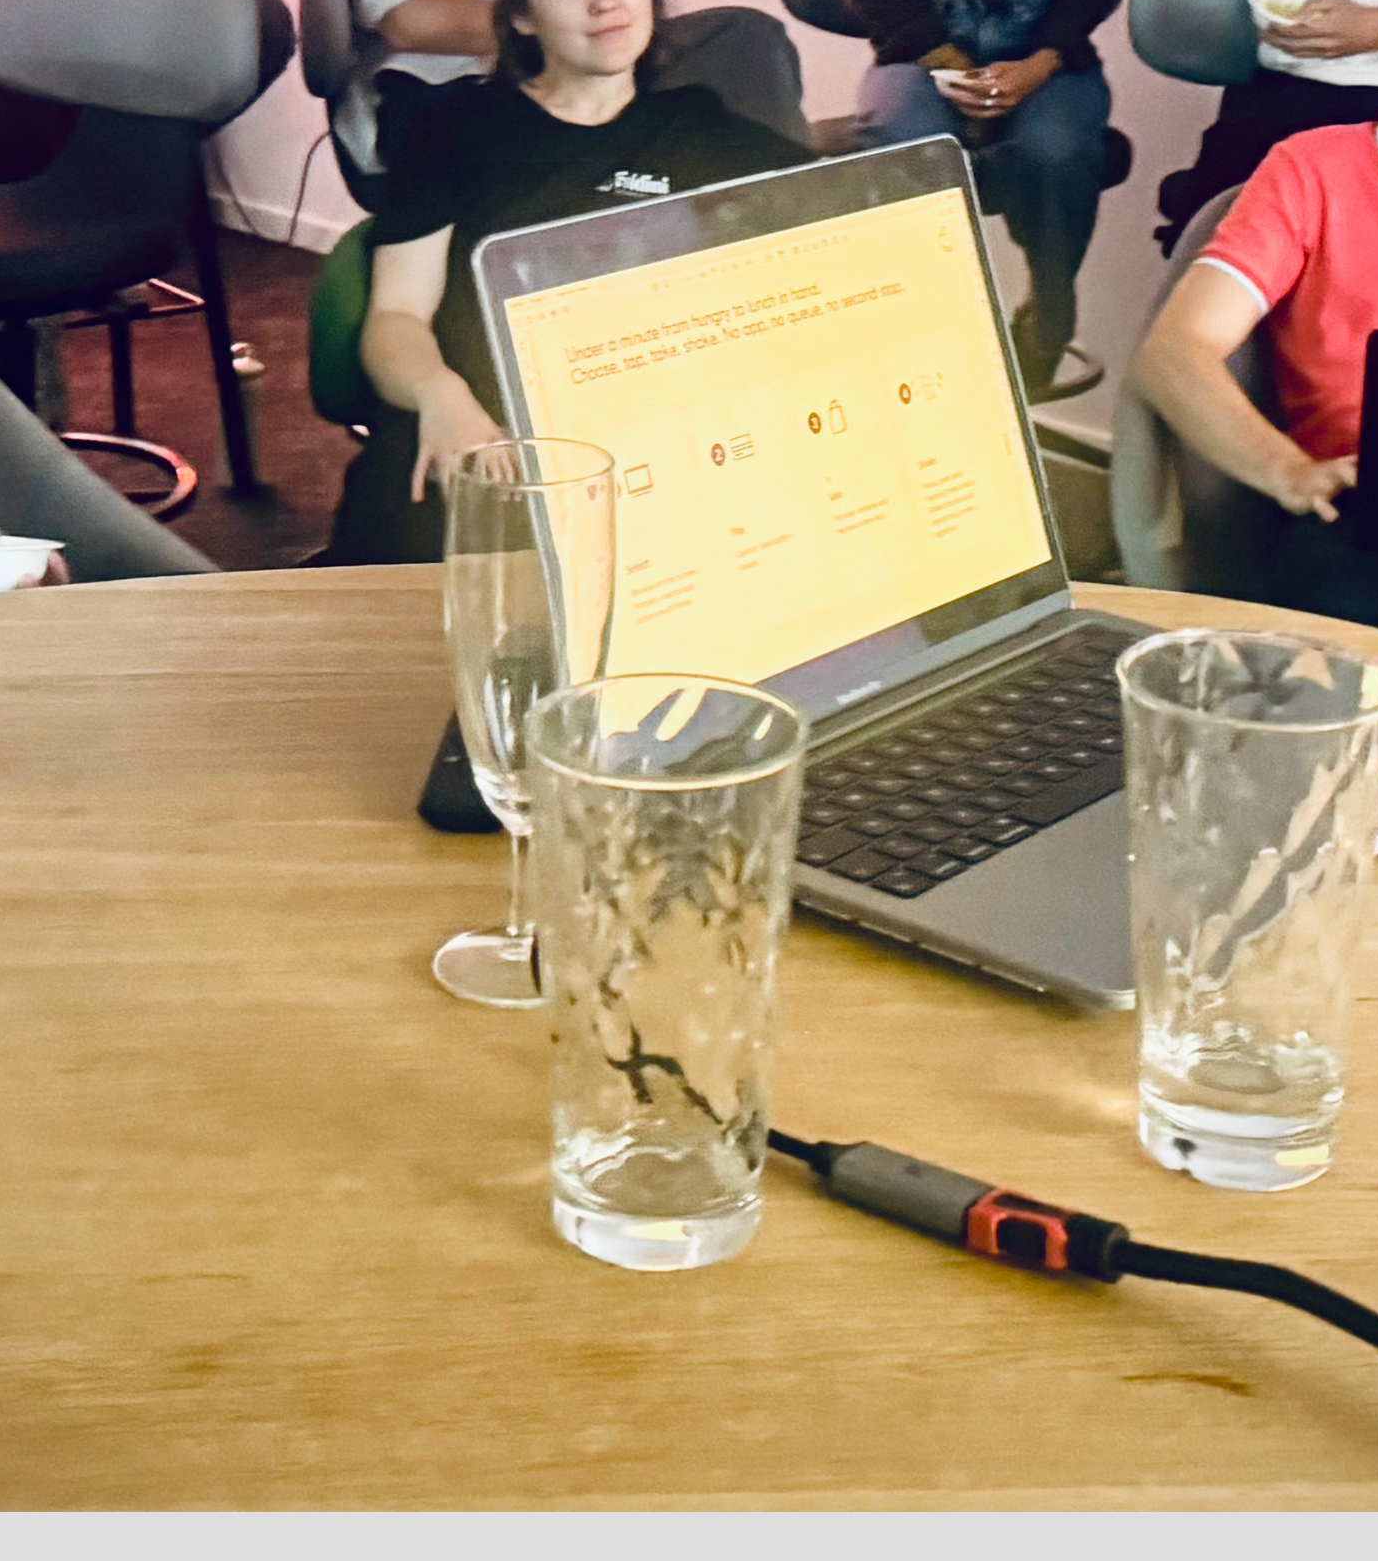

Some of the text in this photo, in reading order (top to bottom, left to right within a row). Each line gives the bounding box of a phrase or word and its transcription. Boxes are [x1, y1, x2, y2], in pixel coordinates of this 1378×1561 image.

[565, 342, 605, 363] Under
[608, 340, 618, 353] a
[620, 328, 660, 350] minute
[661, 321, 690, 337] from
[690, 308, 731, 327] hungry
[732, 303, 745, 318] to
